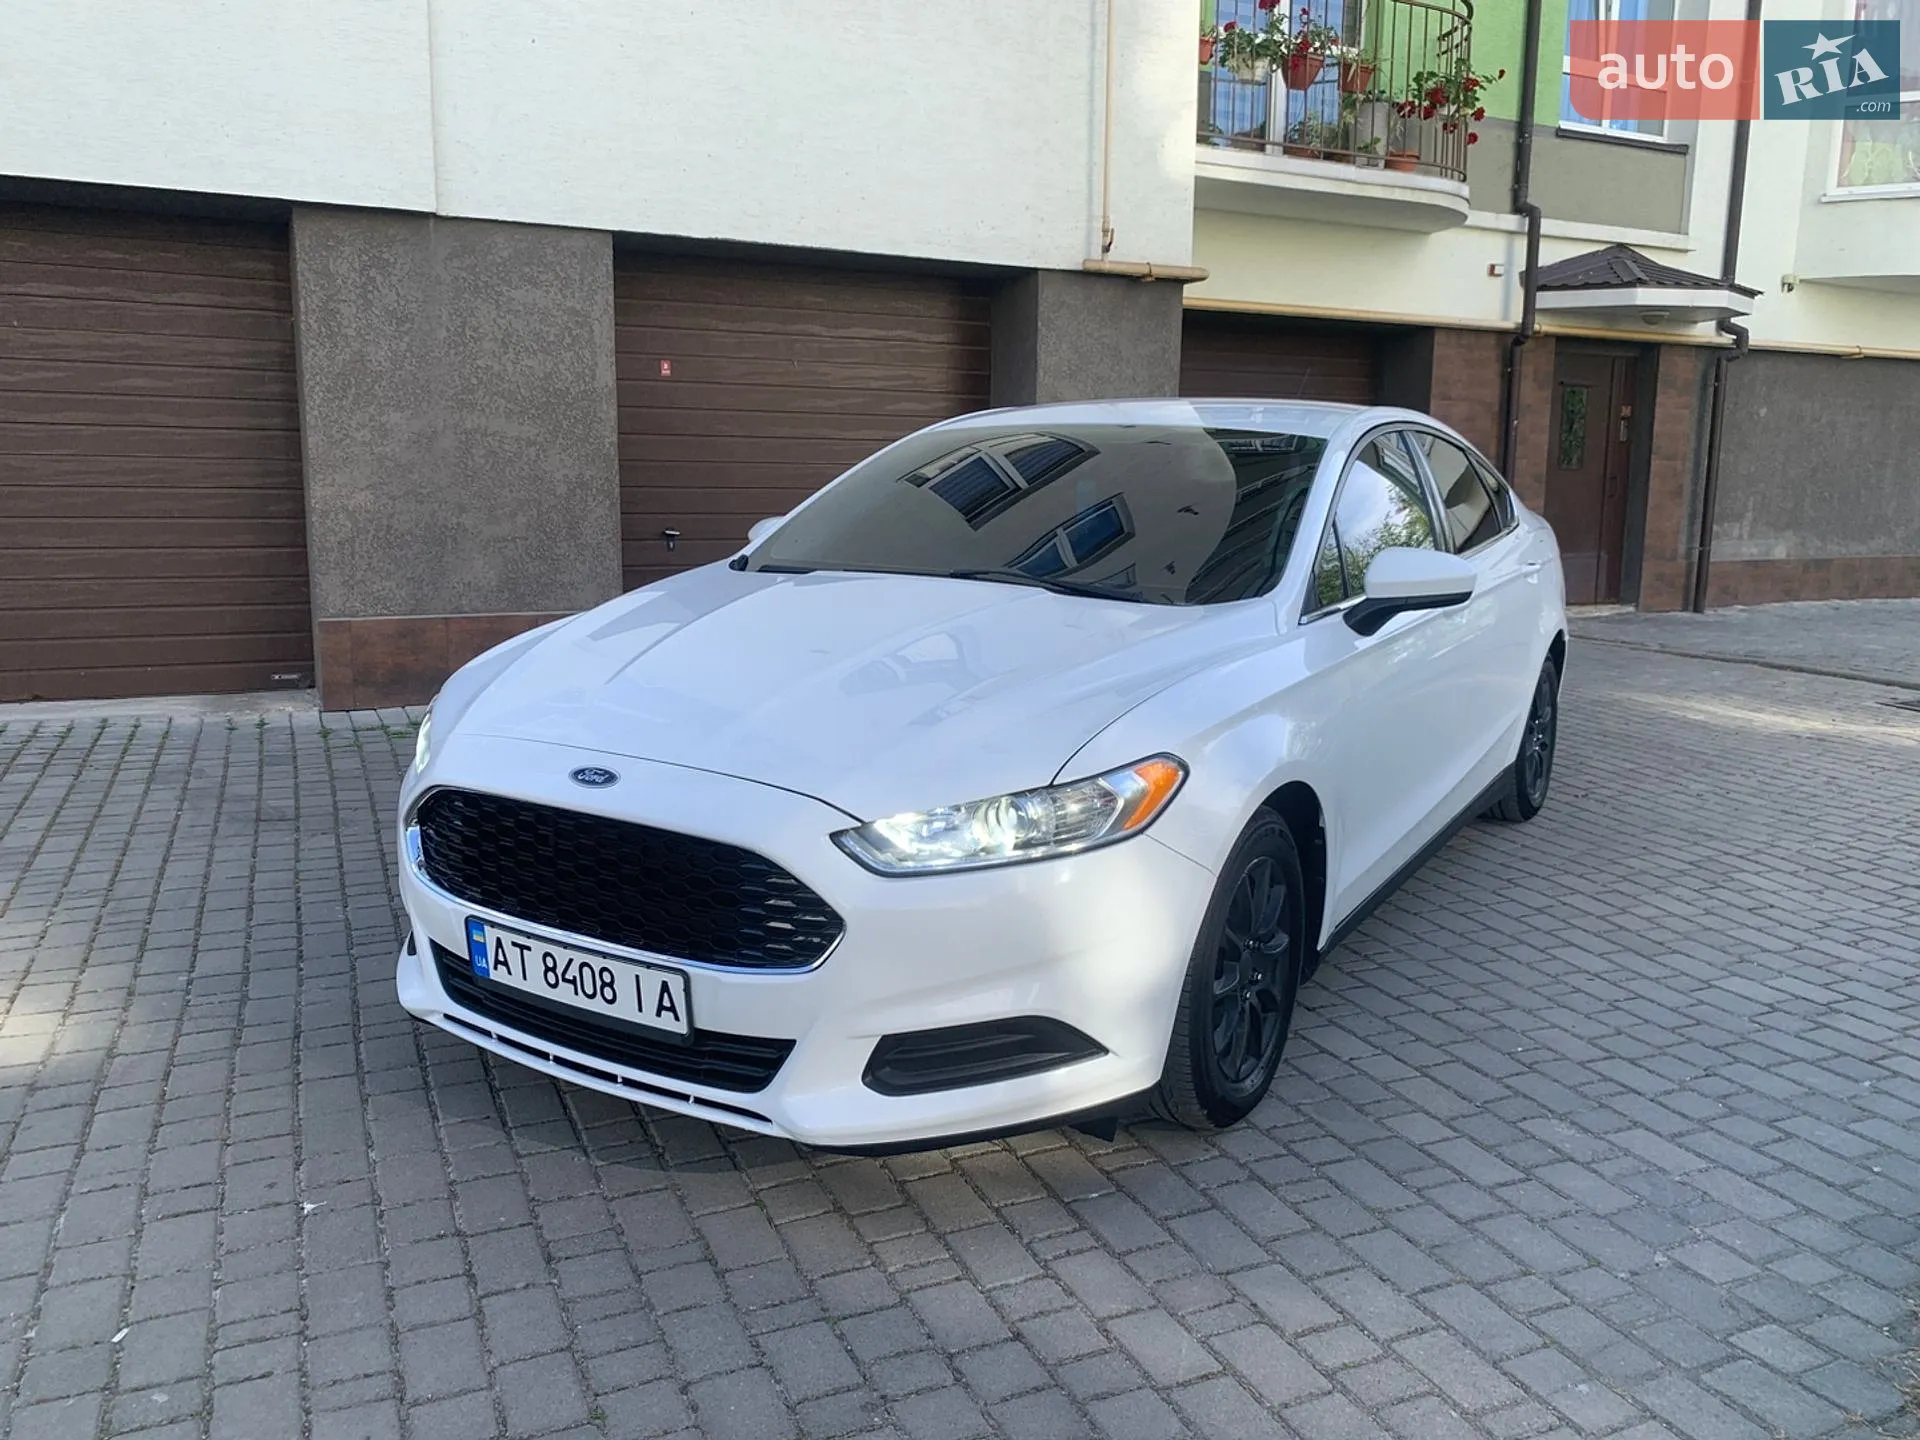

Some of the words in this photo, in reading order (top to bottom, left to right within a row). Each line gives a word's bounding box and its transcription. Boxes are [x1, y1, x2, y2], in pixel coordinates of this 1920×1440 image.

[577, 769, 609, 784] Ford
[474, 955, 488, 968] UA
[493, 936, 532, 981] AT
[541, 951, 618, 1005] 8408
[634, 973, 681, 1022] IA
